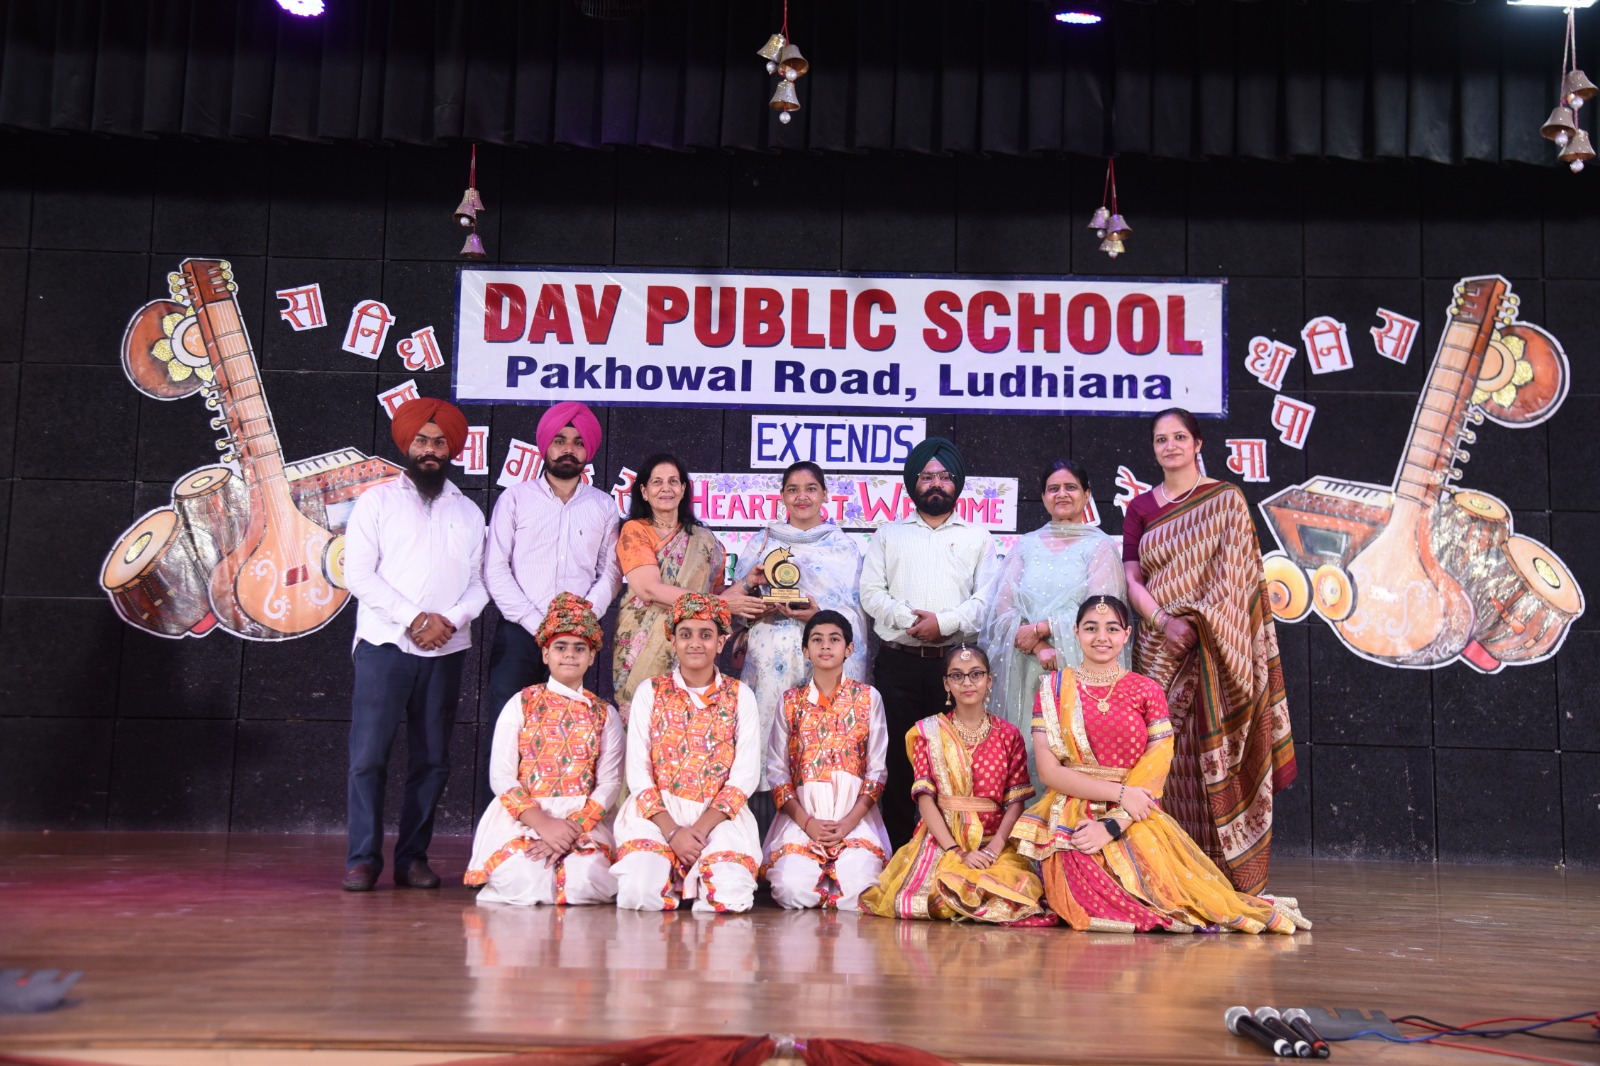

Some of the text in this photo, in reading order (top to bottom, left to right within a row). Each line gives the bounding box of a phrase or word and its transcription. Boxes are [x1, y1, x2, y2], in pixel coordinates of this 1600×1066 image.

[277, 285, 324, 328] सा
[484, 283, 1204, 356] DAV PUBLIC SCHOOL
[1374, 310, 1417, 361] सा
[506, 356, 1172, 402] Pakhowal Road, Ludhiana
[757, 423, 914, 464] EXTENDS
[1275, 398, 1312, 446] पा
[1227, 440, 1267, 479] मा
[690, 480, 1004, 524] HEARTT WEOME
